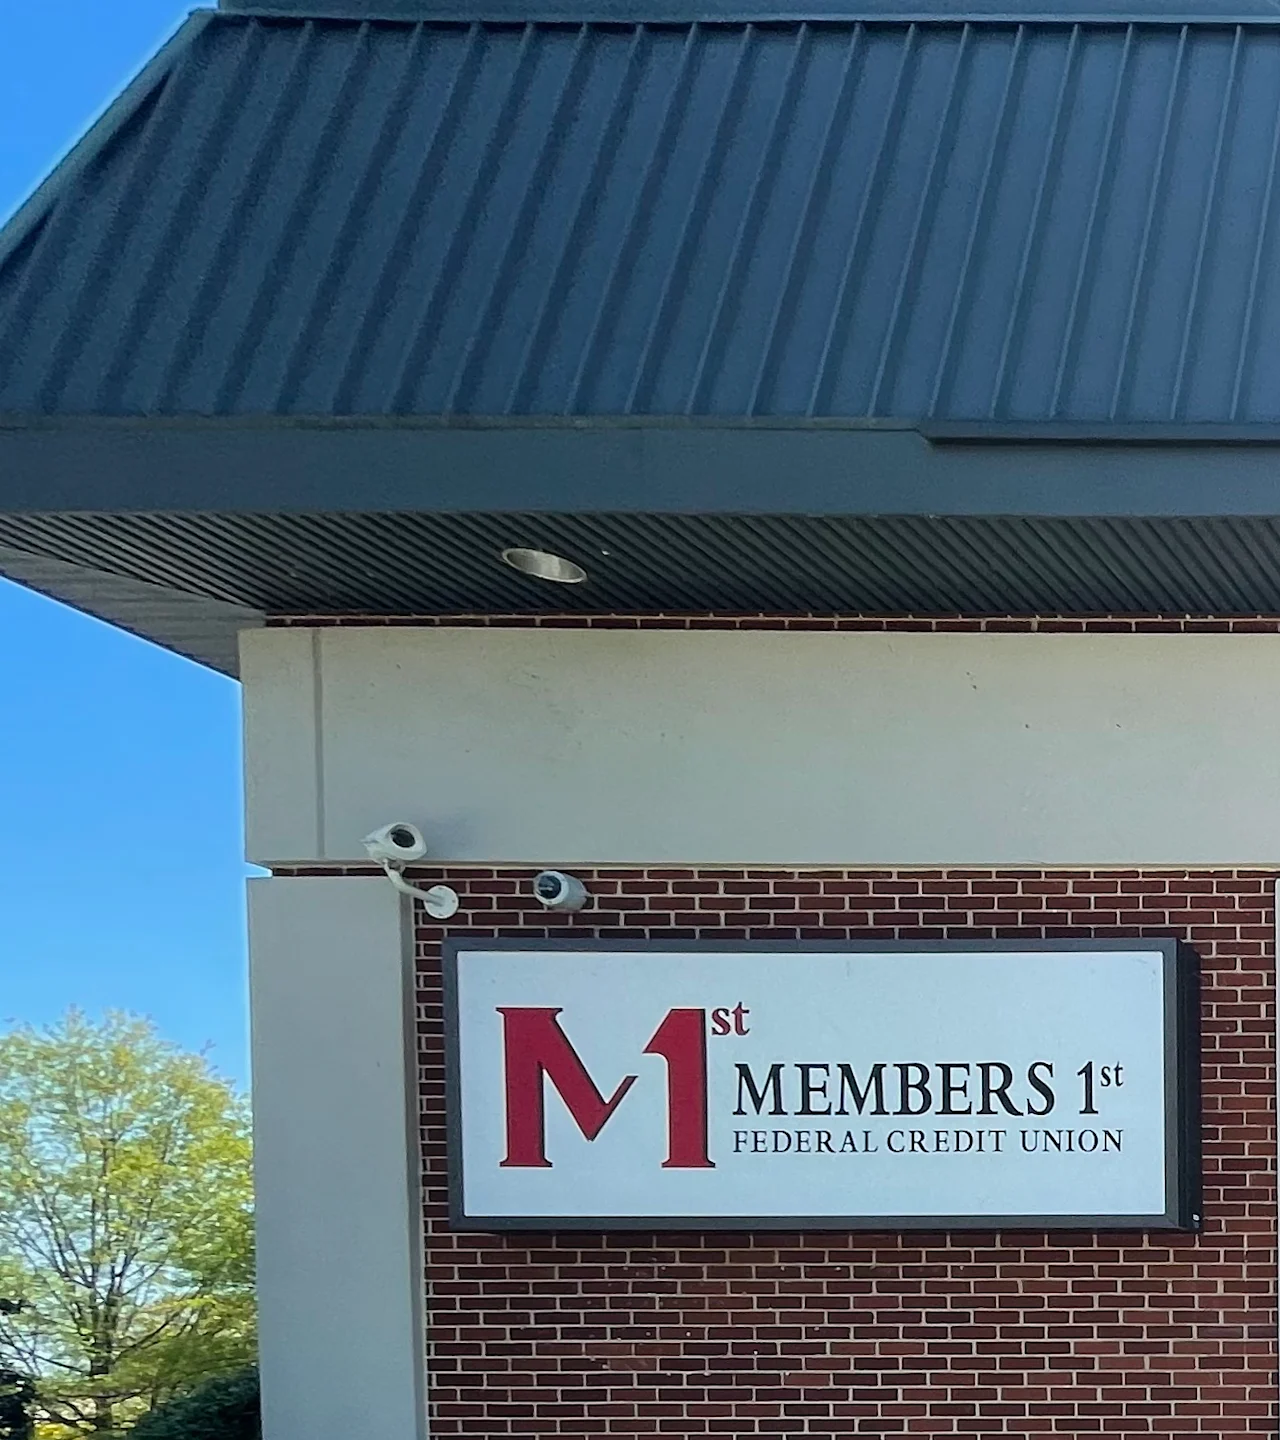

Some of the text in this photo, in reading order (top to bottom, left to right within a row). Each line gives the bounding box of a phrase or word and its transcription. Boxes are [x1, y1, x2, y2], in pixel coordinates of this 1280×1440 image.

[732, 1060, 1124, 1116] MEMBERS 1st
[732, 1128, 1124, 1153] FEDERAL CREDIT UNION
